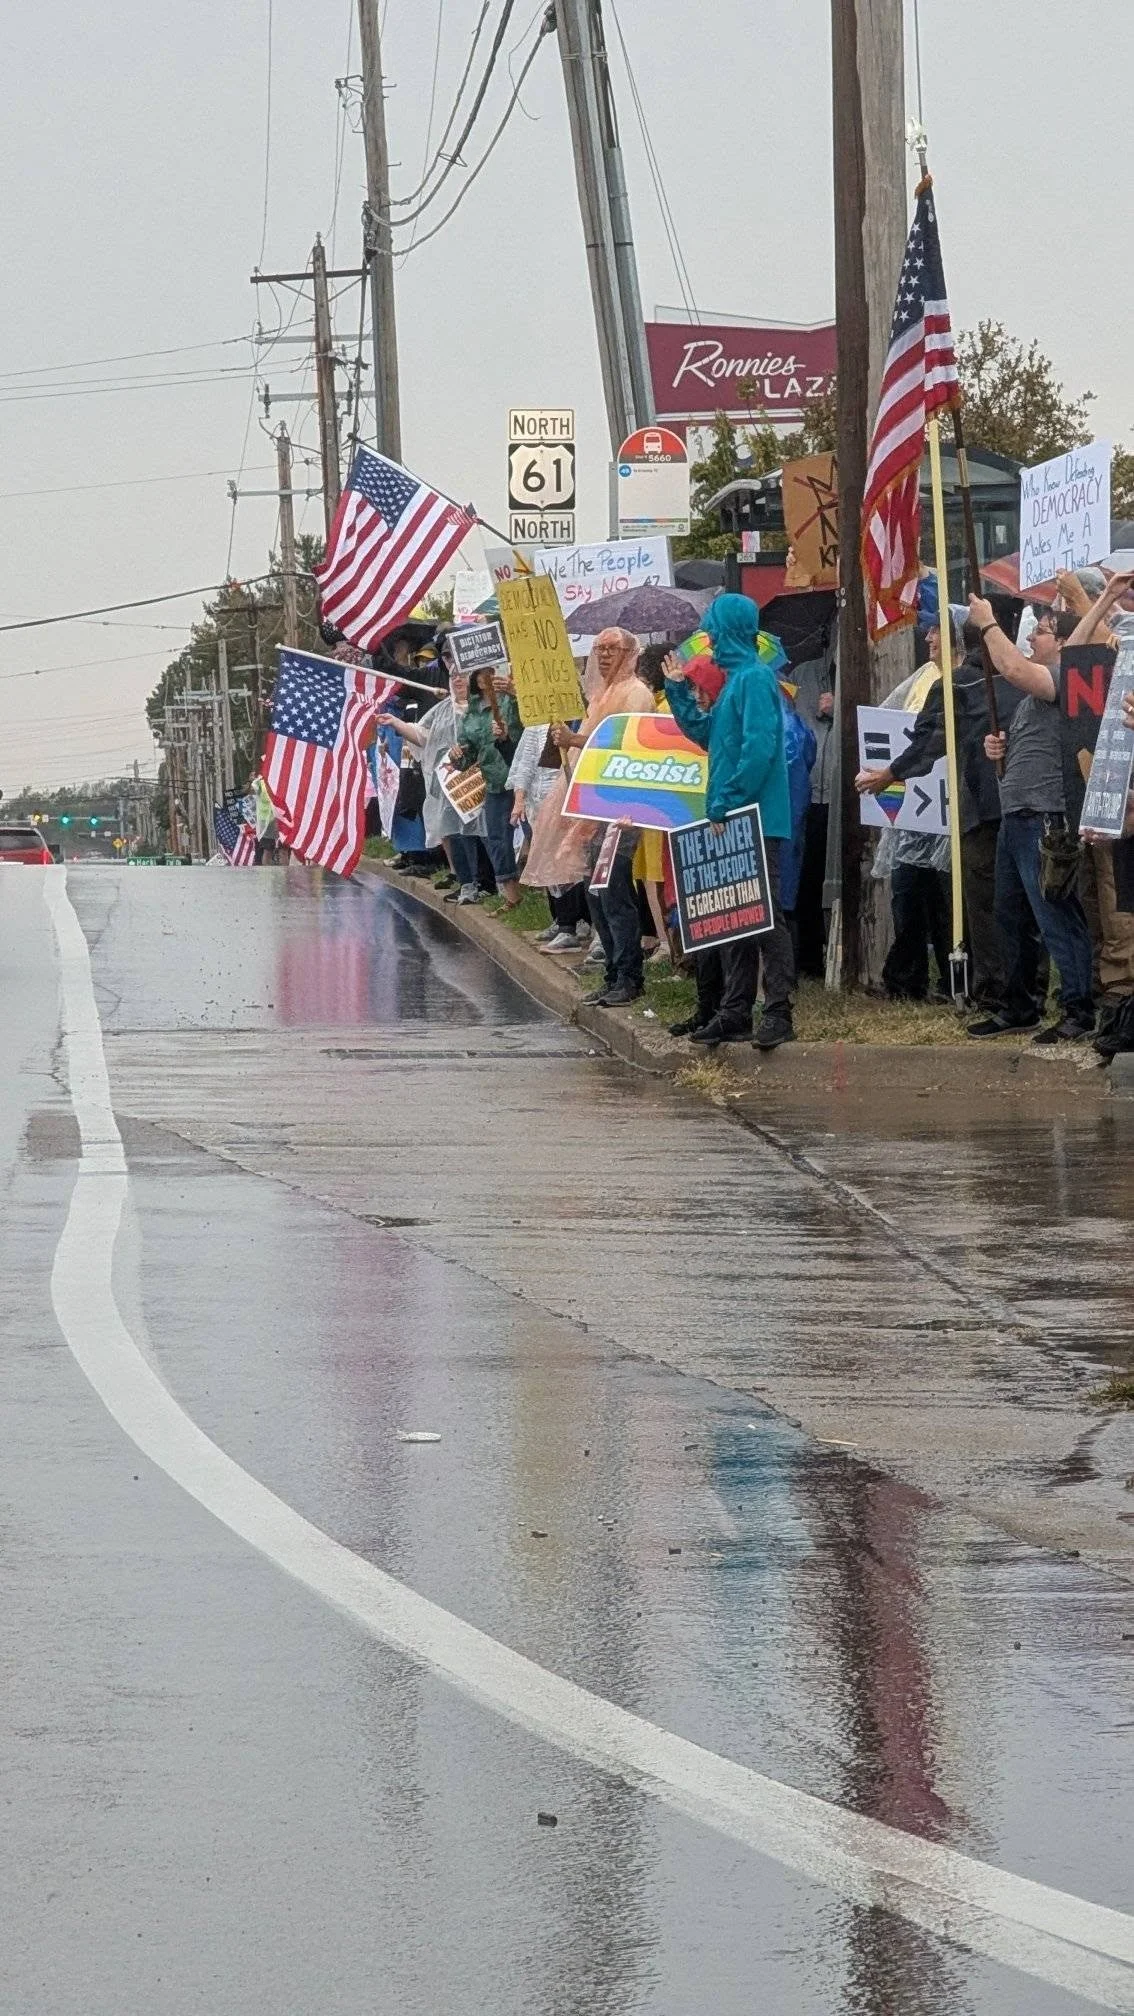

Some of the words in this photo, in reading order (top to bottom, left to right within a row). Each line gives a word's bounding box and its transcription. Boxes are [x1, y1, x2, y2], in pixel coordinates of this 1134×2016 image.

[672, 340, 807, 388] Ronnies
[753, 376, 837, 399] LAZ
[513, 415, 570, 435] NORTH
[648, 454, 671, 462] 5660
[523, 458, 562, 492] 61
[1020, 473, 1040, 500] Who
[1043, 466, 1060, 494] Knew
[1032, 474, 1103, 528] DEMOCRACY
[514, 518, 571, 539] NORTH
[1022, 532, 1052, 561] Makes
[1057, 522, 1075, 549] Me
[1082, 511, 1092, 539] A
[494, 564, 511, 582] NO
[541, 556, 567, 581] We
[567, 549, 595, 577] The
[597, 546, 653, 575] People
[1025, 557, 1056, 587] Radical
[601, 576, 629, 595] NO
[460, 631, 492, 648] DICTATOR
[533, 619, 558, 650] NO
[460, 643, 501, 661] DEMOCRACY
[521, 658, 570, 683] KINGS
[677, 830, 704, 867] THE
[704, 815, 754, 860] POWER
[682, 867, 697, 895] OF
[697, 861, 718, 890] THE
[718, 850, 758, 885] PEOPLE
[685, 896, 696, 919] IS
[696, 885, 737, 916] GREATER
[736, 878, 761, 905] THAN
[689, 921, 703, 940] THE
[702, 913, 730, 937] PEOPLE
[739, 904, 765, 928] POWER
